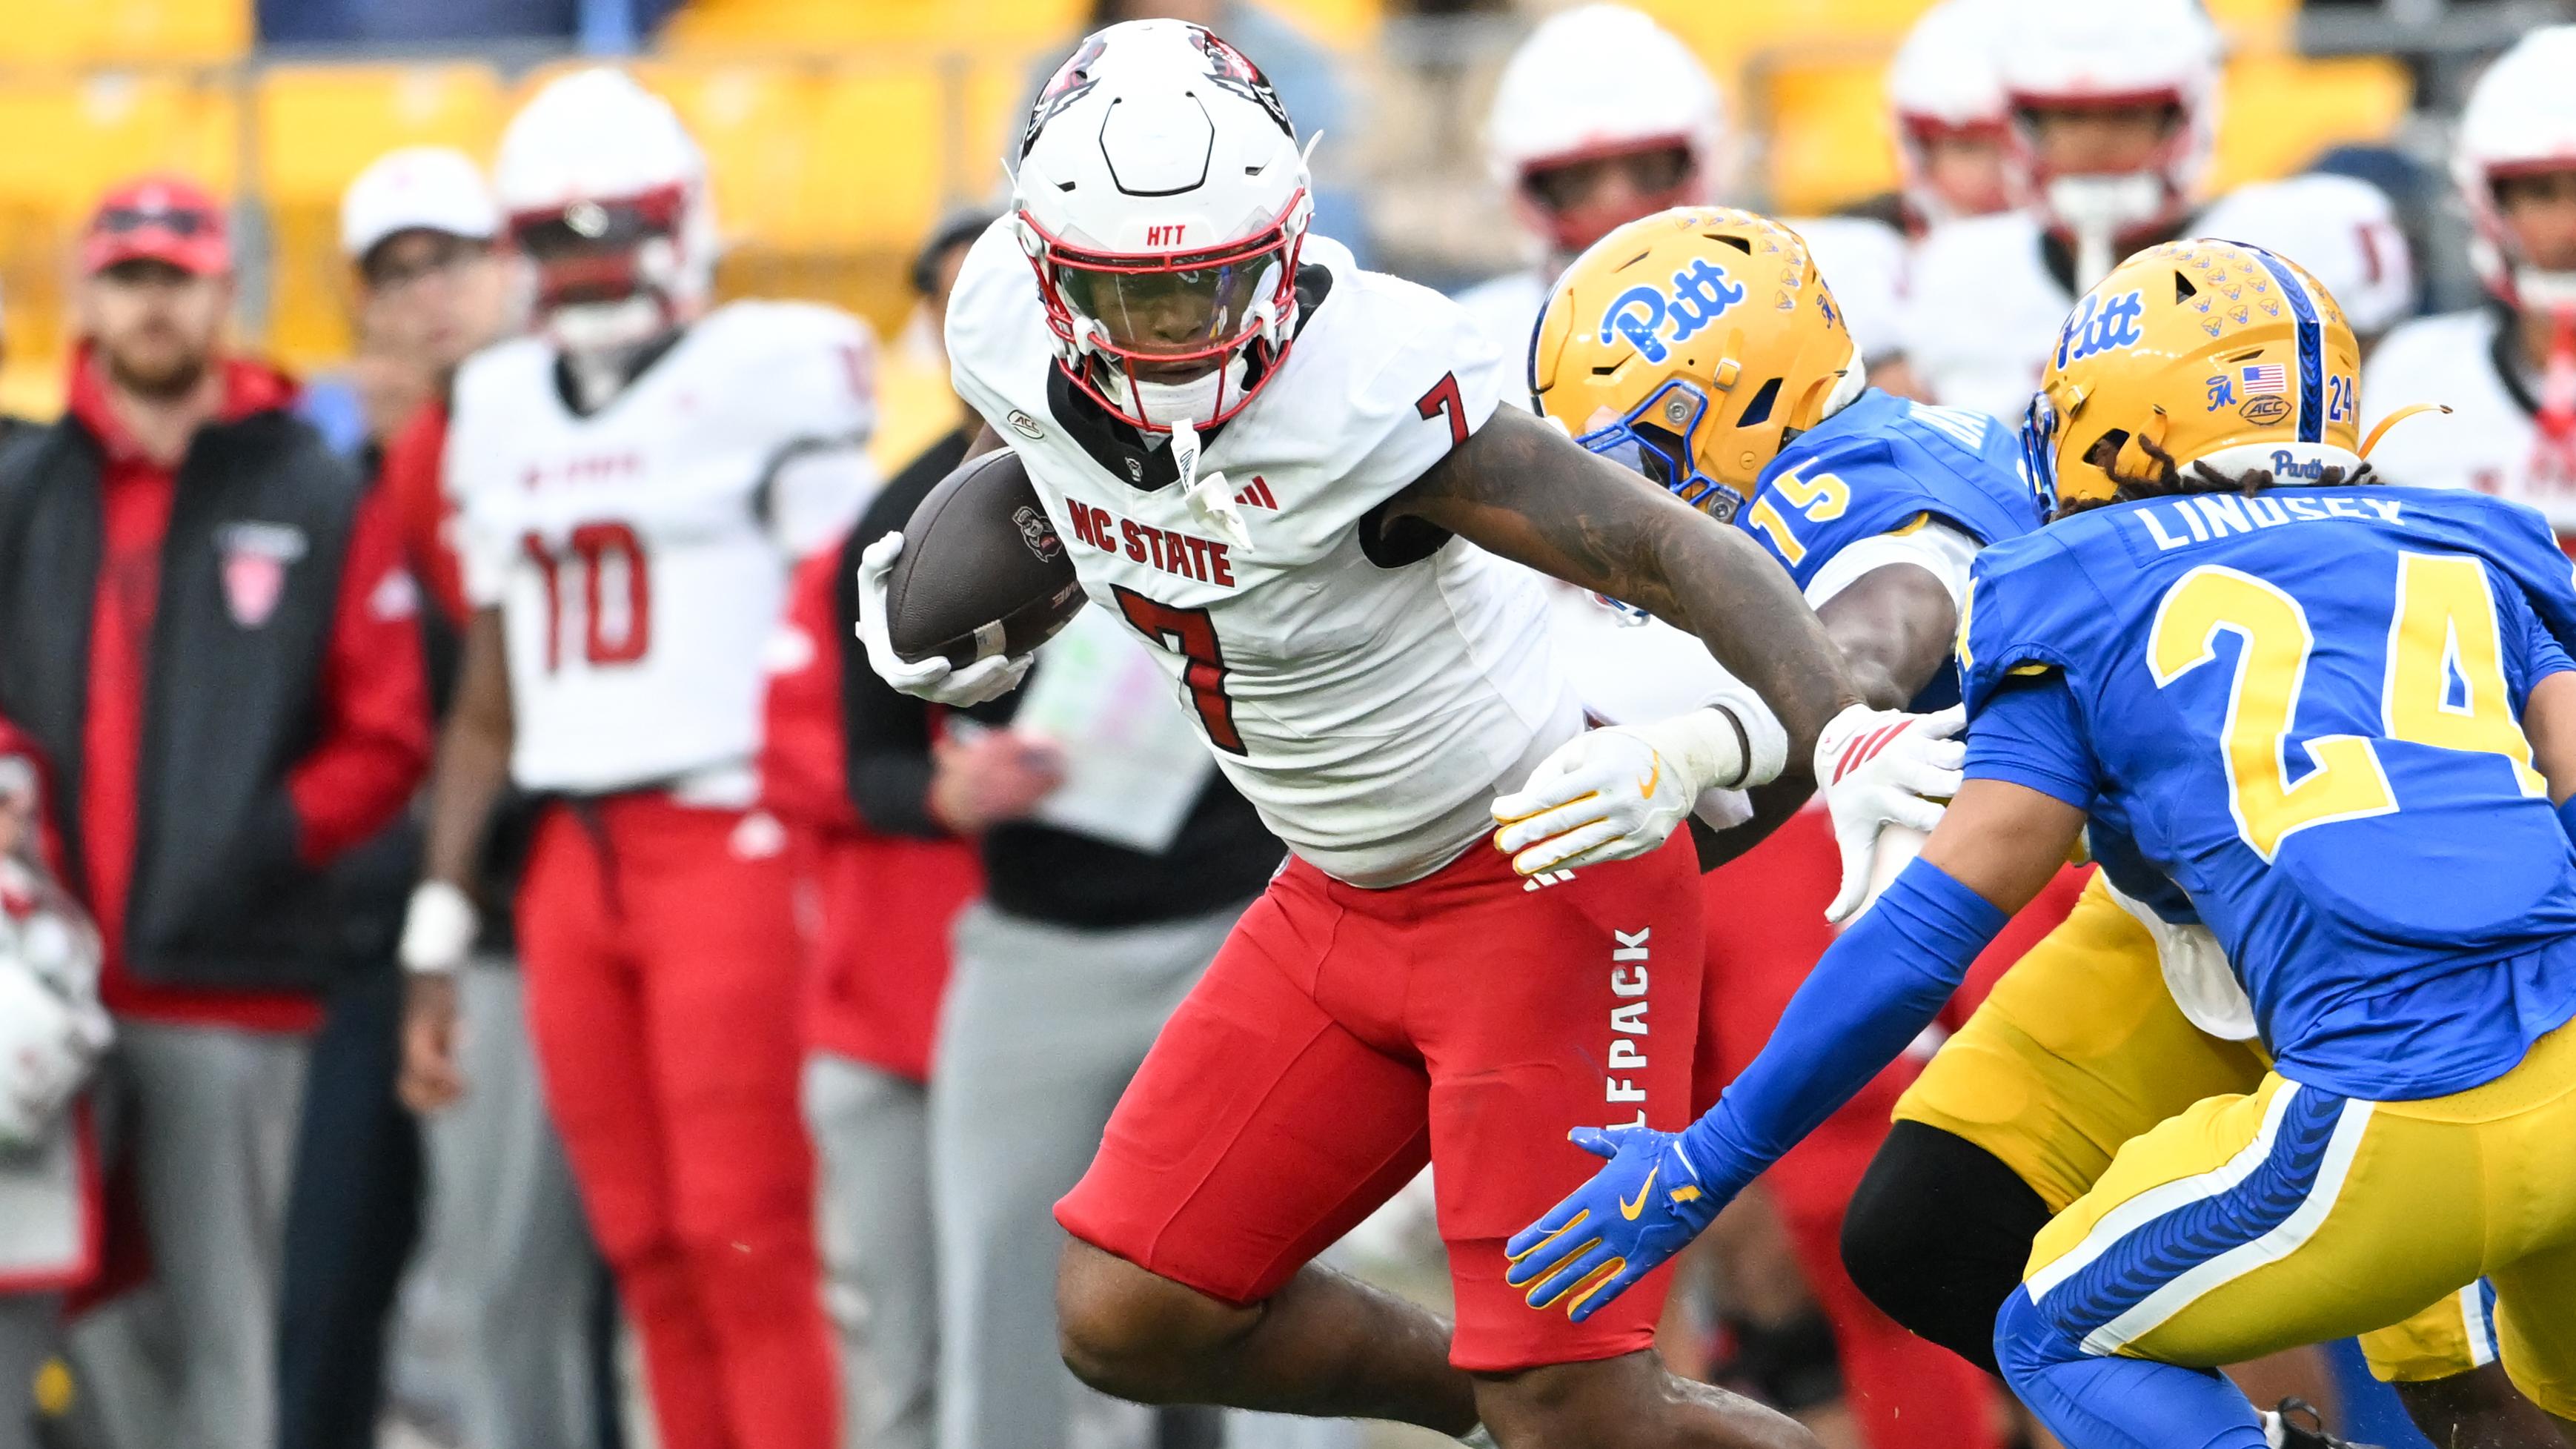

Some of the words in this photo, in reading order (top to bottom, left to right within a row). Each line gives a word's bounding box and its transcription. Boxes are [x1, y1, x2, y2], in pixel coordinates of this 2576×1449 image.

[1147, 225, 1186, 246] HTT
[1601, 259, 1744, 364] Pitt
[2057, 291, 2142, 370] Pitt
[1014, 416, 1040, 432] ACC
[1415, 370, 1470, 448] 7
[2248, 401, 2283, 415] ACC
[2328, 375, 2353, 423] 24
[2269, 449, 2346, 480] Panth
[1065, 497, 1117, 554] NC
[1121, 519, 1235, 588] STATE
[1748, 457, 1850, 568] 15
[2134, 494, 2404, 550] LINDSEY
[522, 523, 650, 672] 10
[1109, 583, 1249, 757] 7
[2146, 550, 2548, 866] 24
[1605, 926, 1650, 1133] LFPACK
